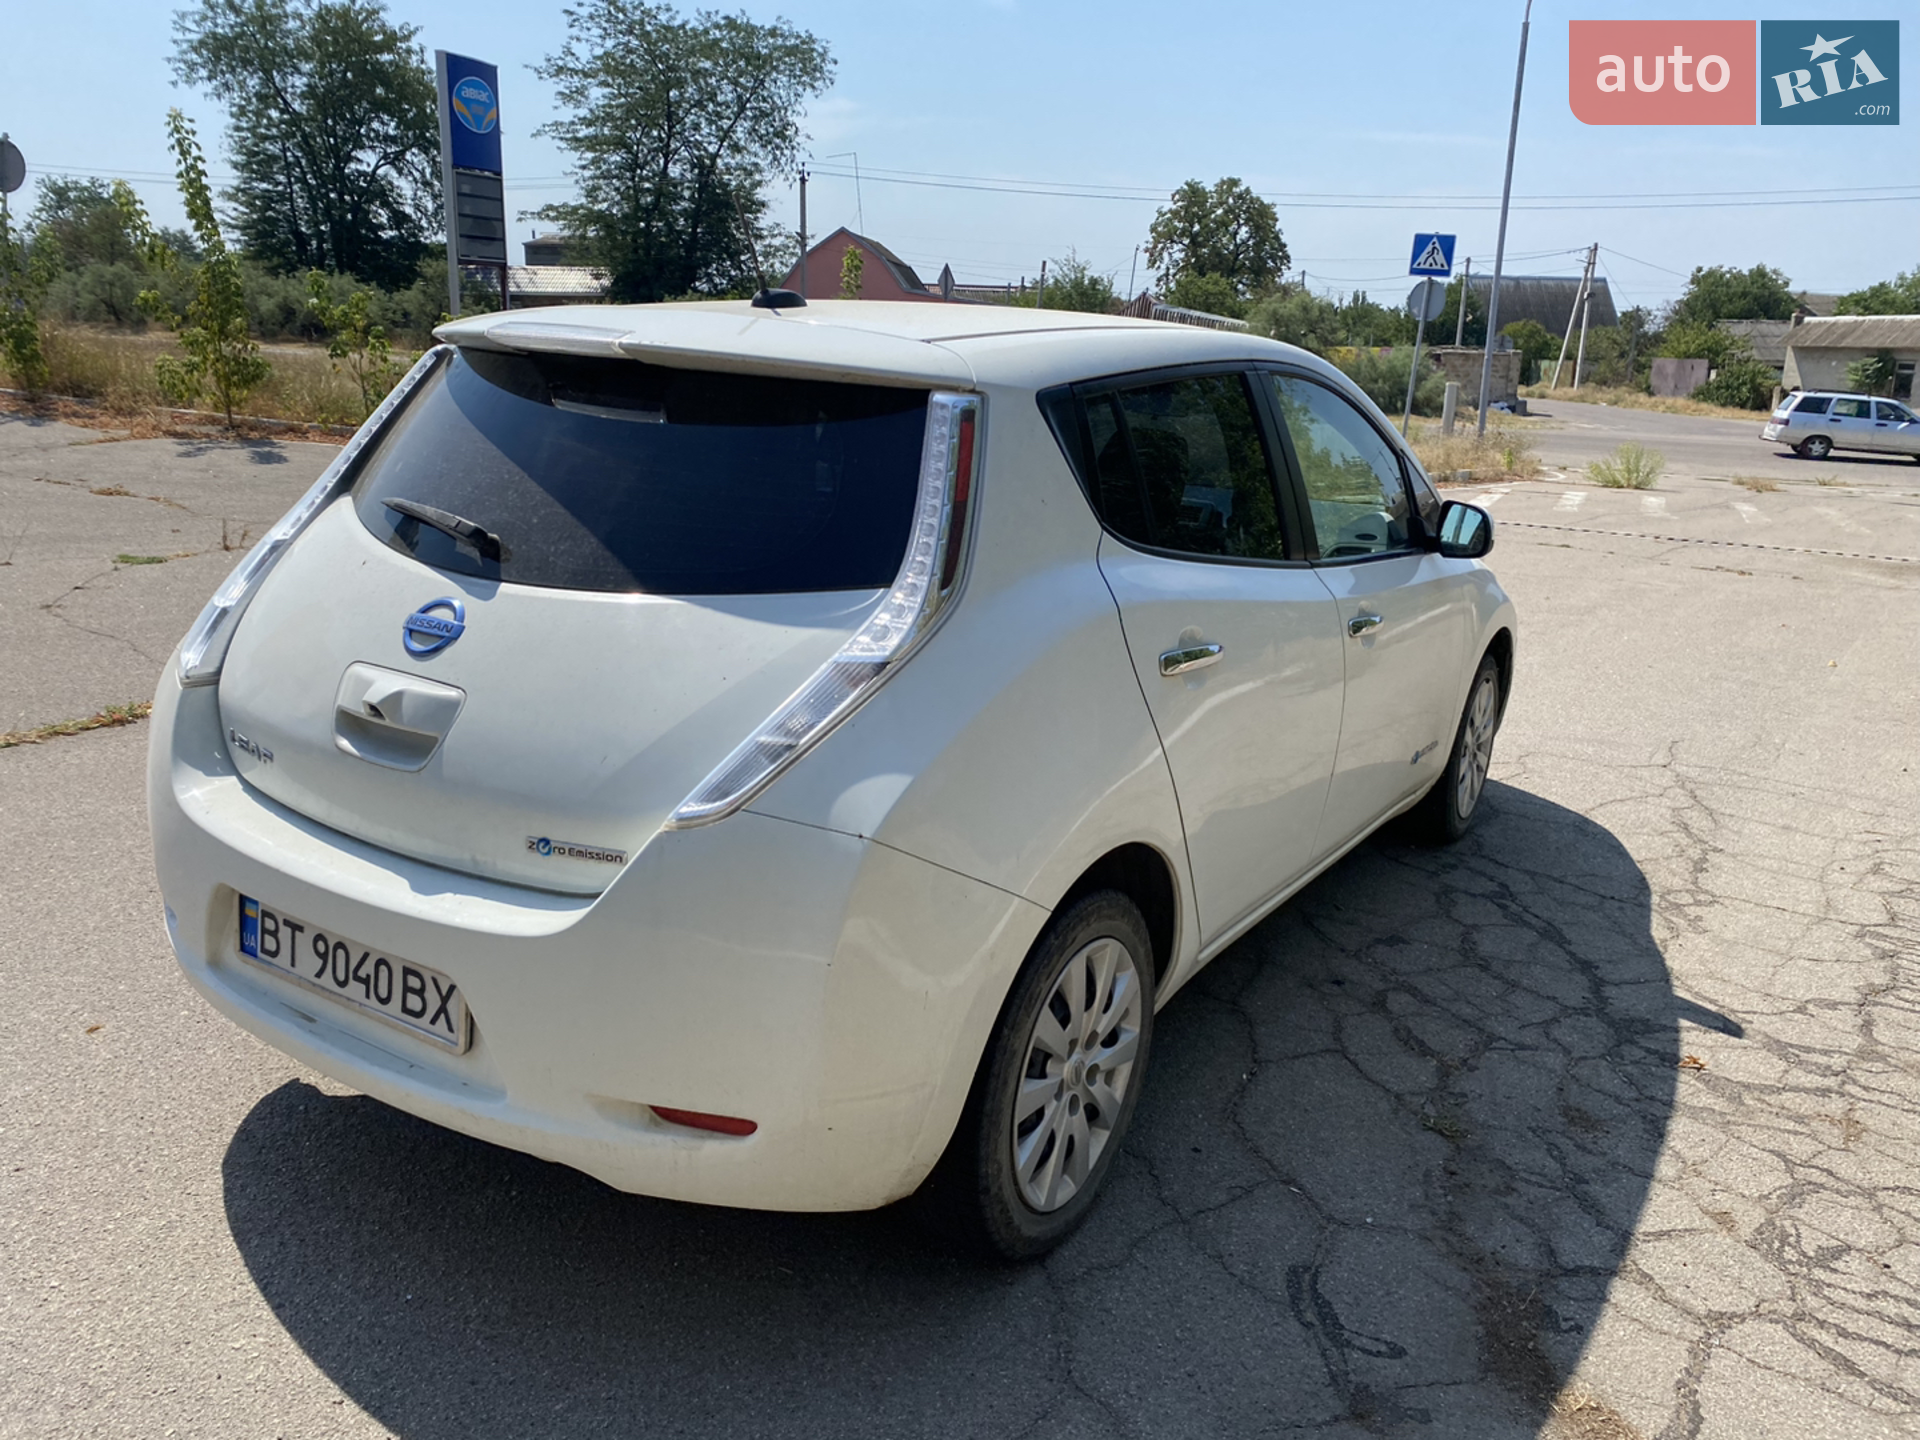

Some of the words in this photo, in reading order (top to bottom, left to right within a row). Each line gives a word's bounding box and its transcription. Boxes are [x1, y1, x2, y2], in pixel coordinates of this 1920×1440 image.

[406, 615, 455, 634] NISSAN
[229, 727, 275, 765] LEAF
[568, 847, 624, 864] Emission
[243, 931, 257, 949] UA
[260, 908, 305, 969] BT
[312, 932, 394, 1006] 9040
[401, 965, 457, 1034] BX
